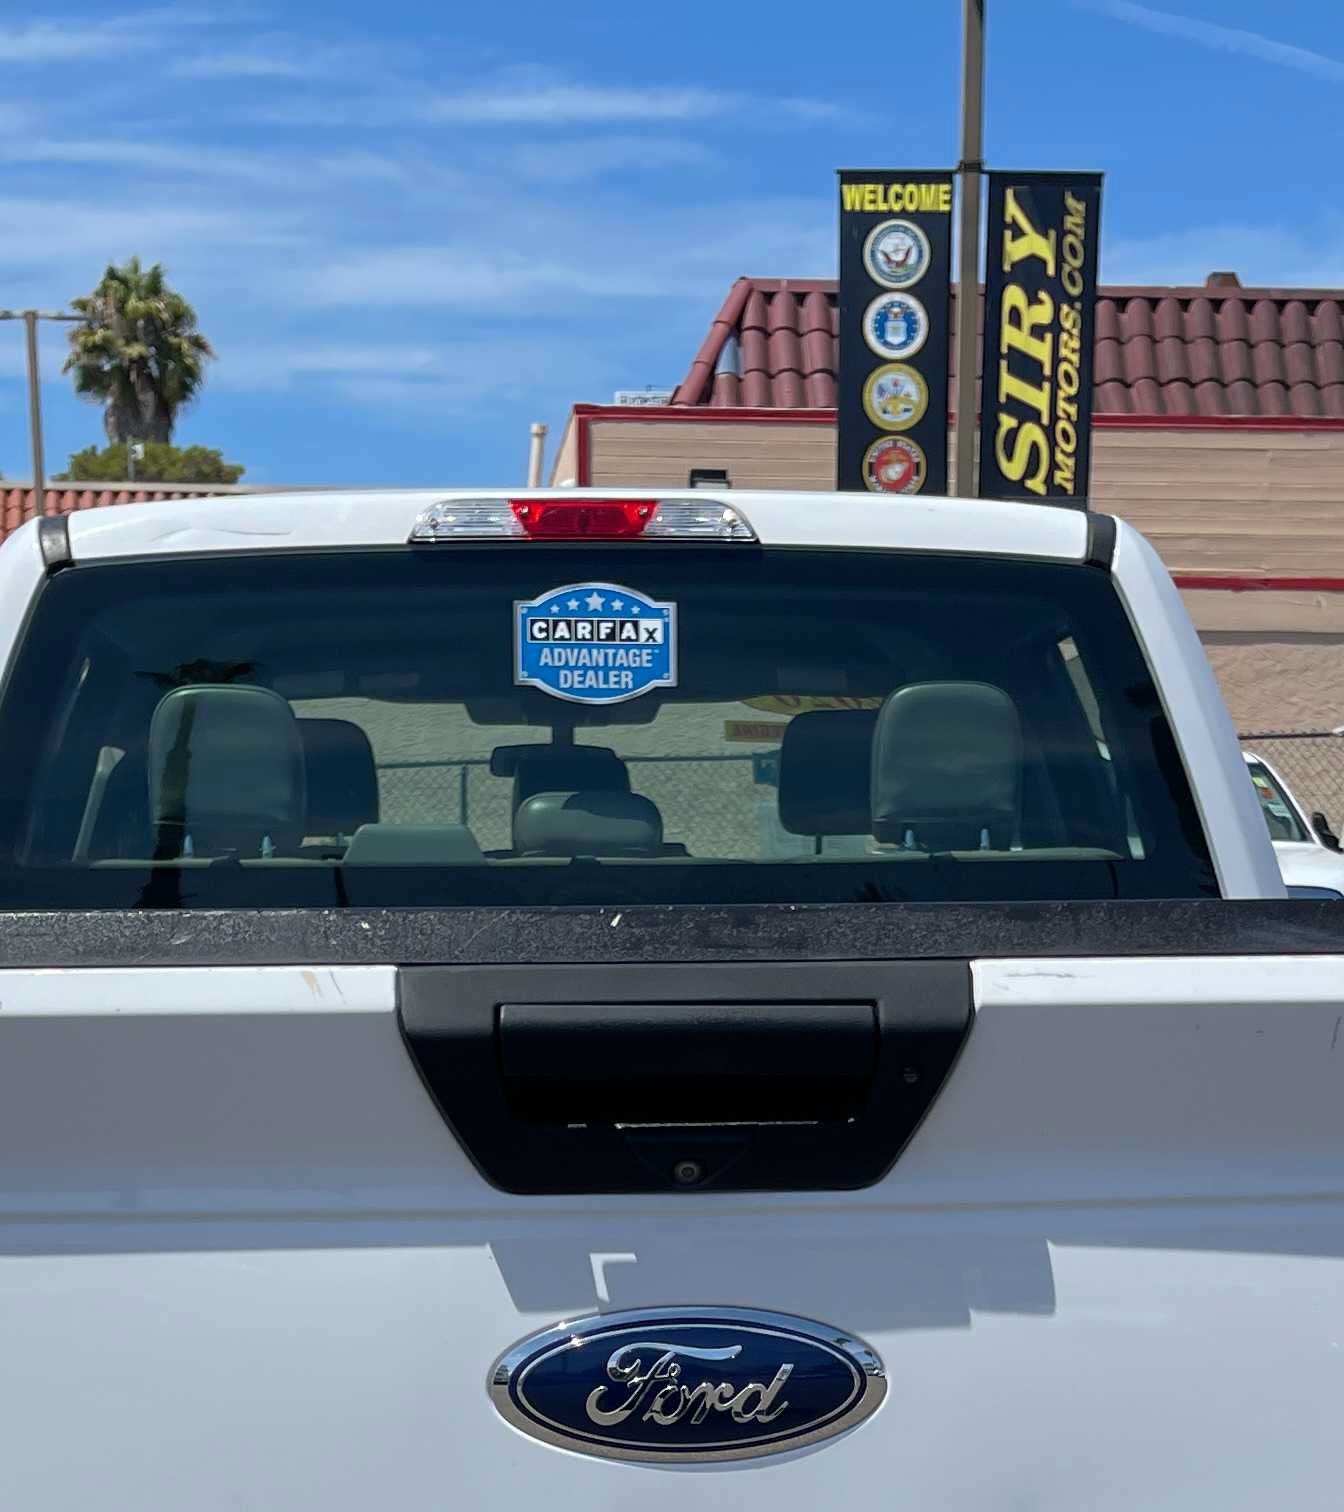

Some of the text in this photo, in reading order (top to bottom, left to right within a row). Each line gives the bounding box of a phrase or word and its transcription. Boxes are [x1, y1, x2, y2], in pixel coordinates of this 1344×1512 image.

[841, 184, 952, 212] WELCOME
[995, 187, 1056, 496] SIRY
[1054, 192, 1087, 494] MOTORS.COM
[530, 620, 661, 643] CARFAX
[539, 648, 652, 667] ADVANTAGE
[559, 670, 633, 689] DEALER
[586, 1342, 794, 1426] Ford
